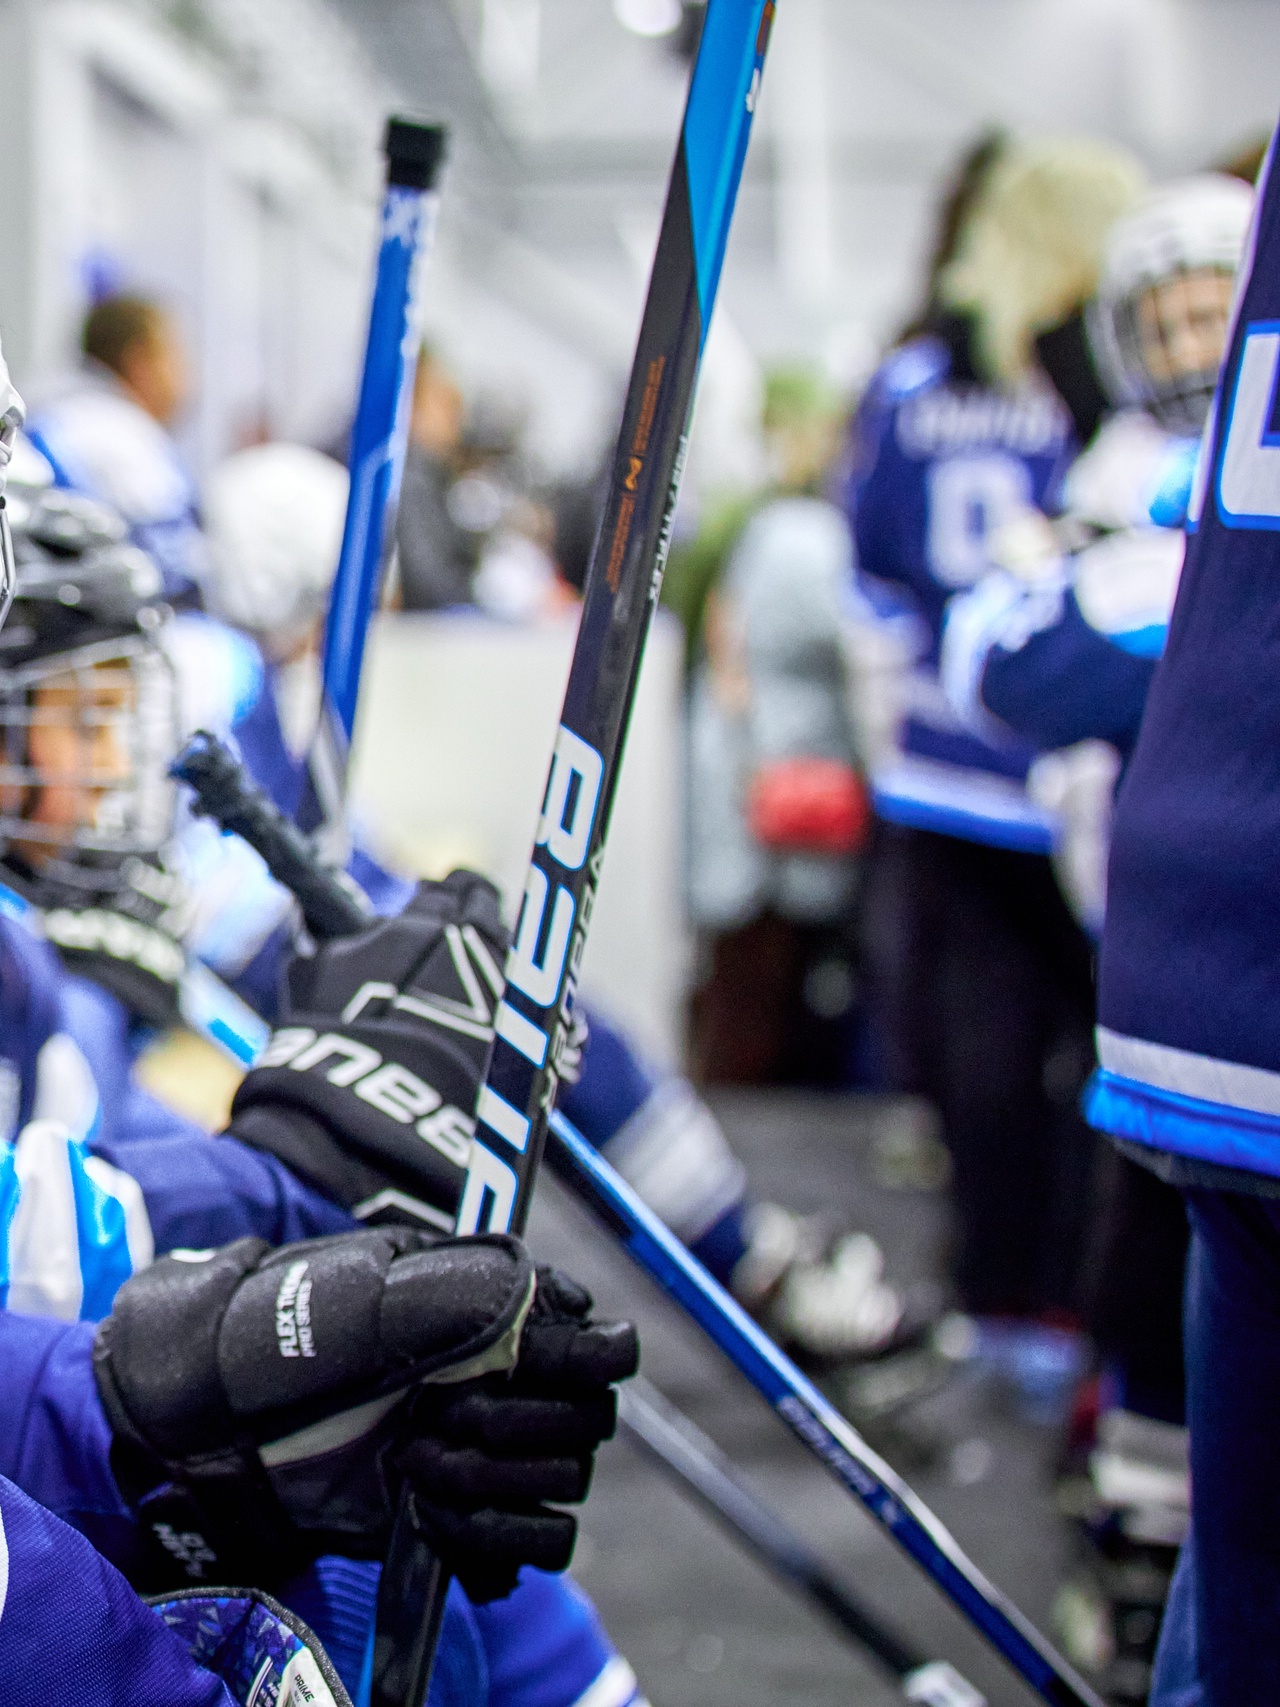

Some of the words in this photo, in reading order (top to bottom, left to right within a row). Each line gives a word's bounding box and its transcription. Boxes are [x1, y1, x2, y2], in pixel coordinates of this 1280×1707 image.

[275, 1308, 300, 1357] FLEX
[297, 1326, 317, 1357] PRO
[294, 1673, 315, 1703] PRIME
